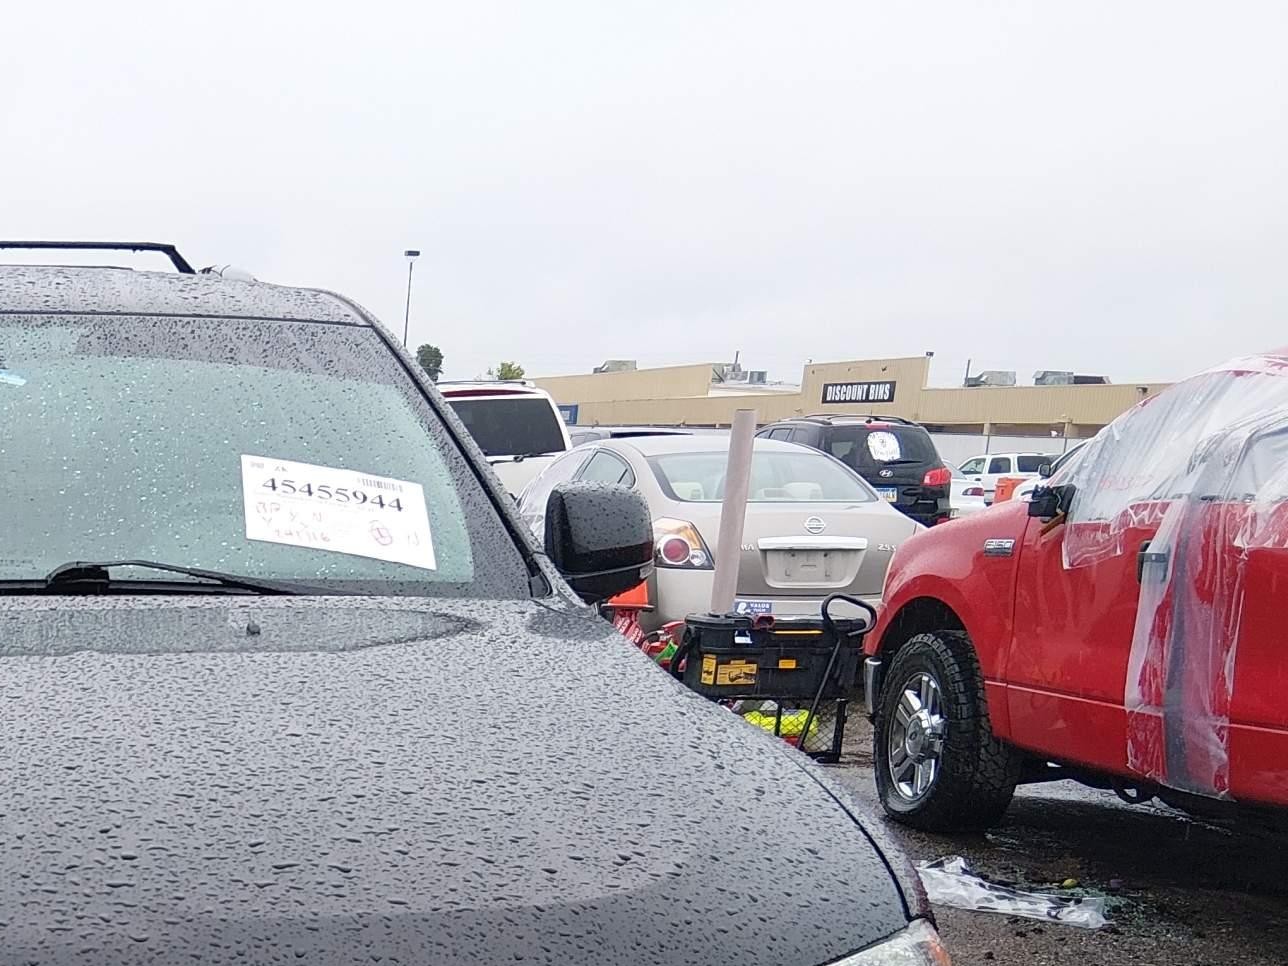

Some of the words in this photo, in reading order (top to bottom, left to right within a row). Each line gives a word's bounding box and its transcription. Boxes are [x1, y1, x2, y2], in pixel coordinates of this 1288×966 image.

[826, 385, 868, 401] DISCOUNT
[869, 383, 890, 400] BINS
[262, 477, 404, 512] 45455944
